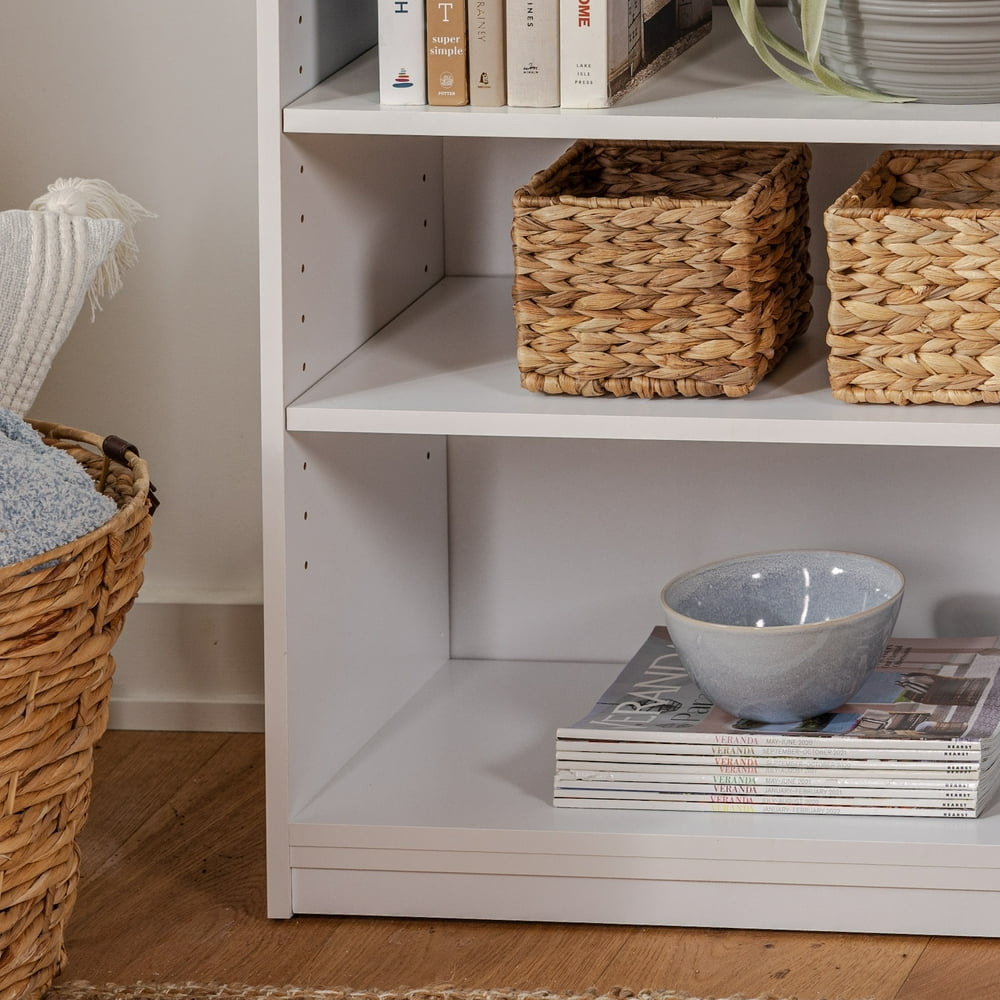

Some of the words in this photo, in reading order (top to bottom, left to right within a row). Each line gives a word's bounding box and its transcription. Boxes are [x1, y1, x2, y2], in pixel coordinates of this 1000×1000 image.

[476, 1, 487, 42] RAINEY
[432, 36, 460, 47] super
[430, 46, 463, 58] simple
[589, 644, 688, 729] VERAND
[714, 736, 759, 745] VERANDA
[711, 746, 755, 755] VERANDA
[714, 758, 759, 766] VERANDA
[713, 776, 756, 784] VERANDA
[714, 785, 758, 794] VERANDA
